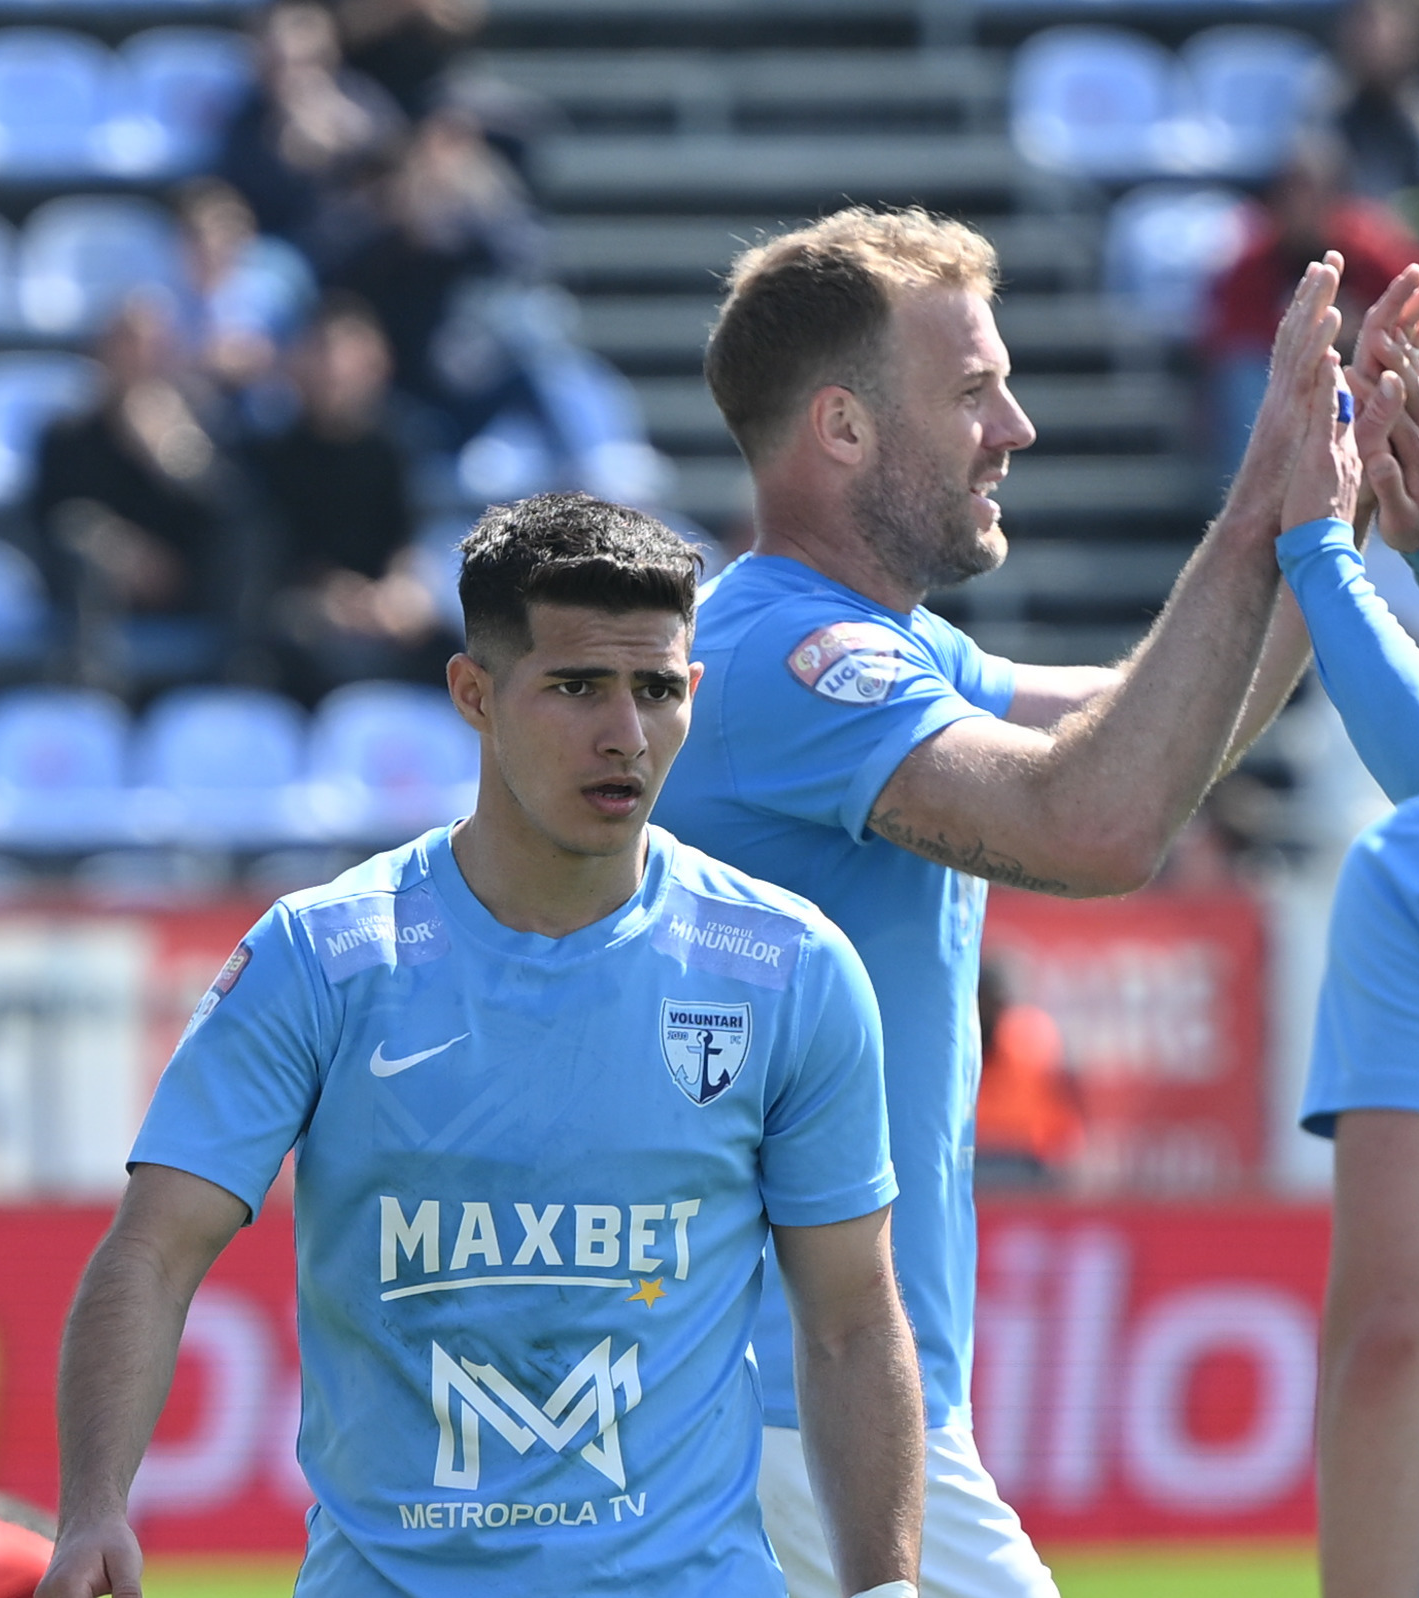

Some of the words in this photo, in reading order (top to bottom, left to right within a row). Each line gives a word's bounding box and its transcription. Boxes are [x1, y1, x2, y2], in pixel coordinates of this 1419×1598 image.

[668, 914, 782, 968] MINUNILOR
[706, 921, 754, 939] IZVORUL
[669, 1011, 743, 1029] VOLUNTARI
[380, 1195, 701, 1283] MAXBET
[399, 1499, 598, 1529] METROPOLA
[609, 1492, 647, 1522] TV
